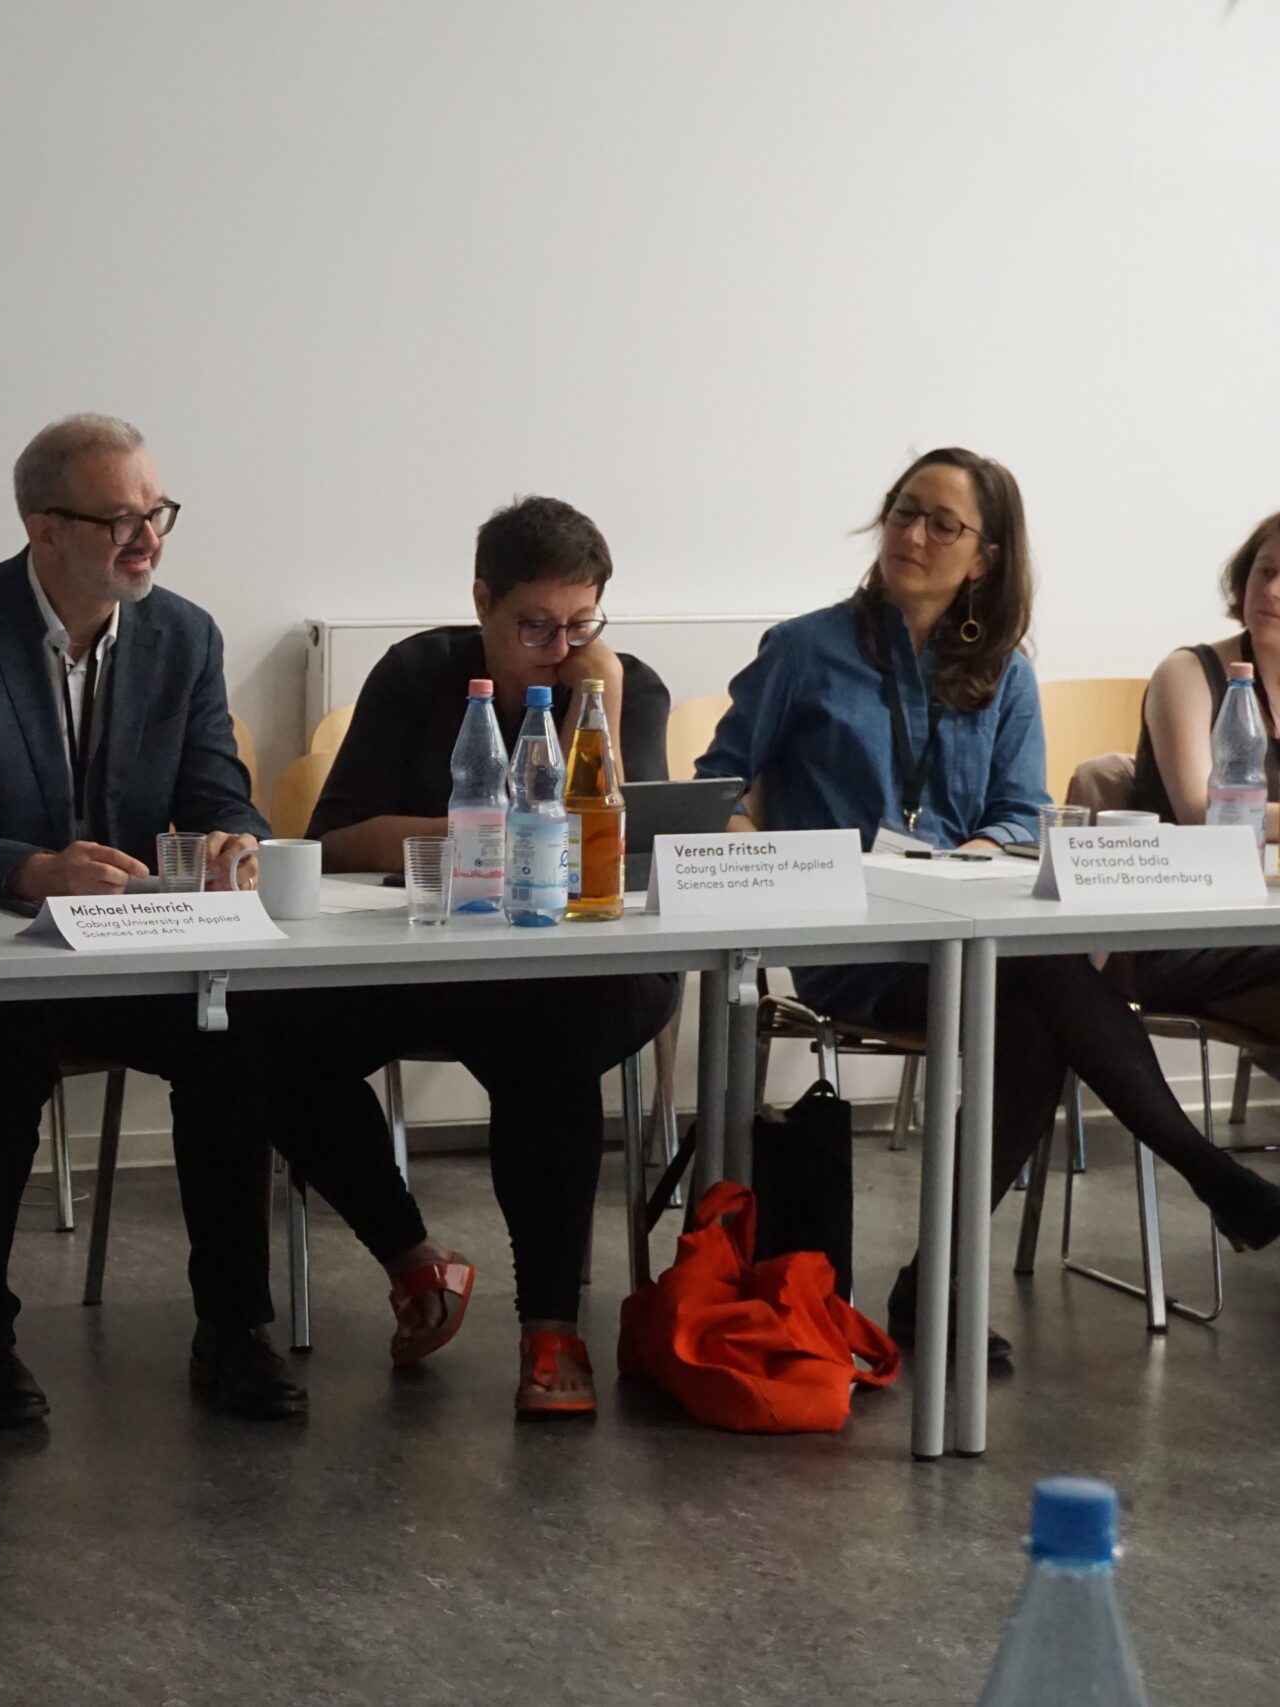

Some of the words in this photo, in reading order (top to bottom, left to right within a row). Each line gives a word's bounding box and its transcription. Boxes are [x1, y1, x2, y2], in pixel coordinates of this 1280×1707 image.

[1069, 837, 1094, 849] Eva
[1098, 836, 1160, 848] Samland
[675, 844, 724, 857] Verena
[728, 843, 777, 856] Fritsch
[675, 863, 717, 876] Coburg
[719, 860, 774, 873] University
[778, 860, 789, 871] of
[792, 859, 834, 871] Applied
[1071, 855, 1134, 867] Vorstand
[1139, 854, 1169, 866] bdia
[677, 879, 724, 890] Sciences
[727, 877, 749, 888] and
[752, 876, 775, 888] Arts
[1075, 872, 1213, 885] Berlin/Brandenburg
[70, 905, 128, 916] Michael
[132, 902, 194, 914] Heinrich
[76, 919, 120, 930] Coburg
[122, 916, 180, 928] University
[182, 916, 194, 924] of
[198, 914, 241, 925] Applied
[82, 929, 133, 938] Sciences
[136, 928, 158, 936] and
[161, 926, 186, 934] Arts
